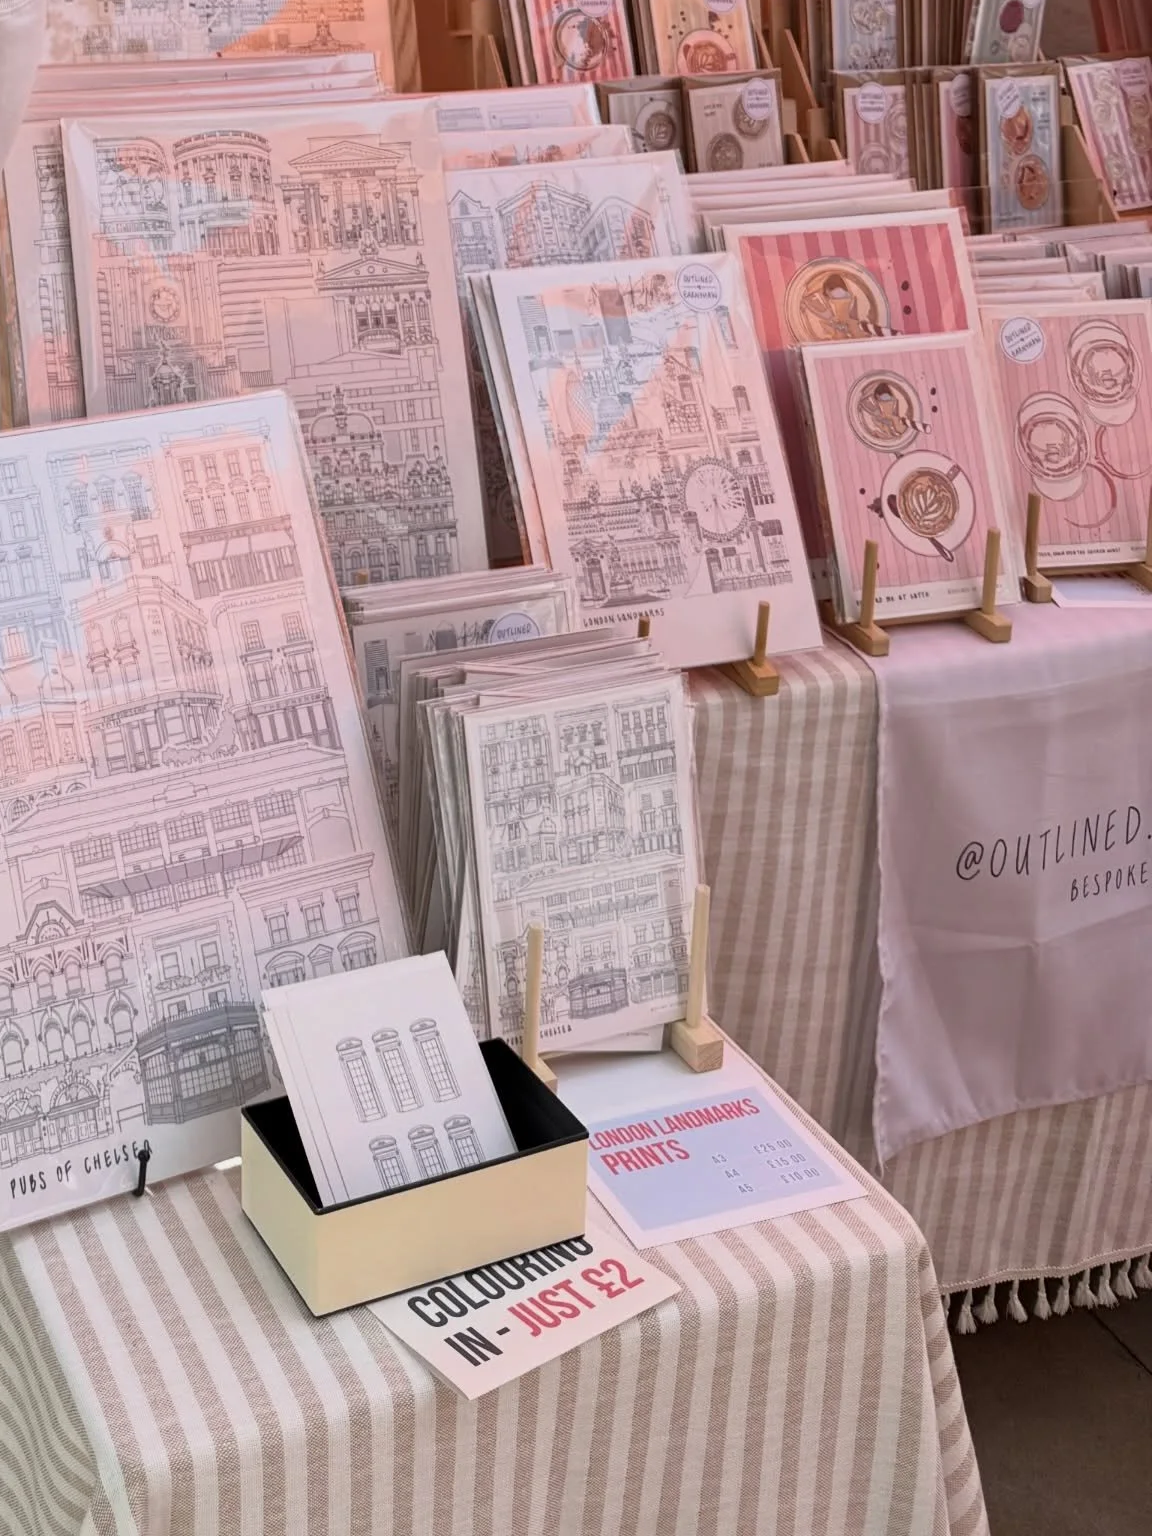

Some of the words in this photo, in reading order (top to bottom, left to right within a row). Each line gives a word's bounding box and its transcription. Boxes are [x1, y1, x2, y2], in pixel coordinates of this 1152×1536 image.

[1070, 862, 1148, 902] BESPOKE
[589, 1120, 658, 1152] LONDON
[653, 1097, 761, 1135] LANDMARKS
[10, 1171, 47, 1199] PUBS
[56, 1160, 72, 1183] OF
[84, 1139, 153, 1174] CHELSEA
[600, 1138, 691, 1176] PRINTS
[711, 1153, 728, 1165] A3
[724, 1168, 741, 1179] A4
[737, 1182, 754, 1194] A5
[443, 1326, 504, 1367] IN
[507, 1279, 596, 1337] JUST
[581, 1258, 645, 1299] £2
